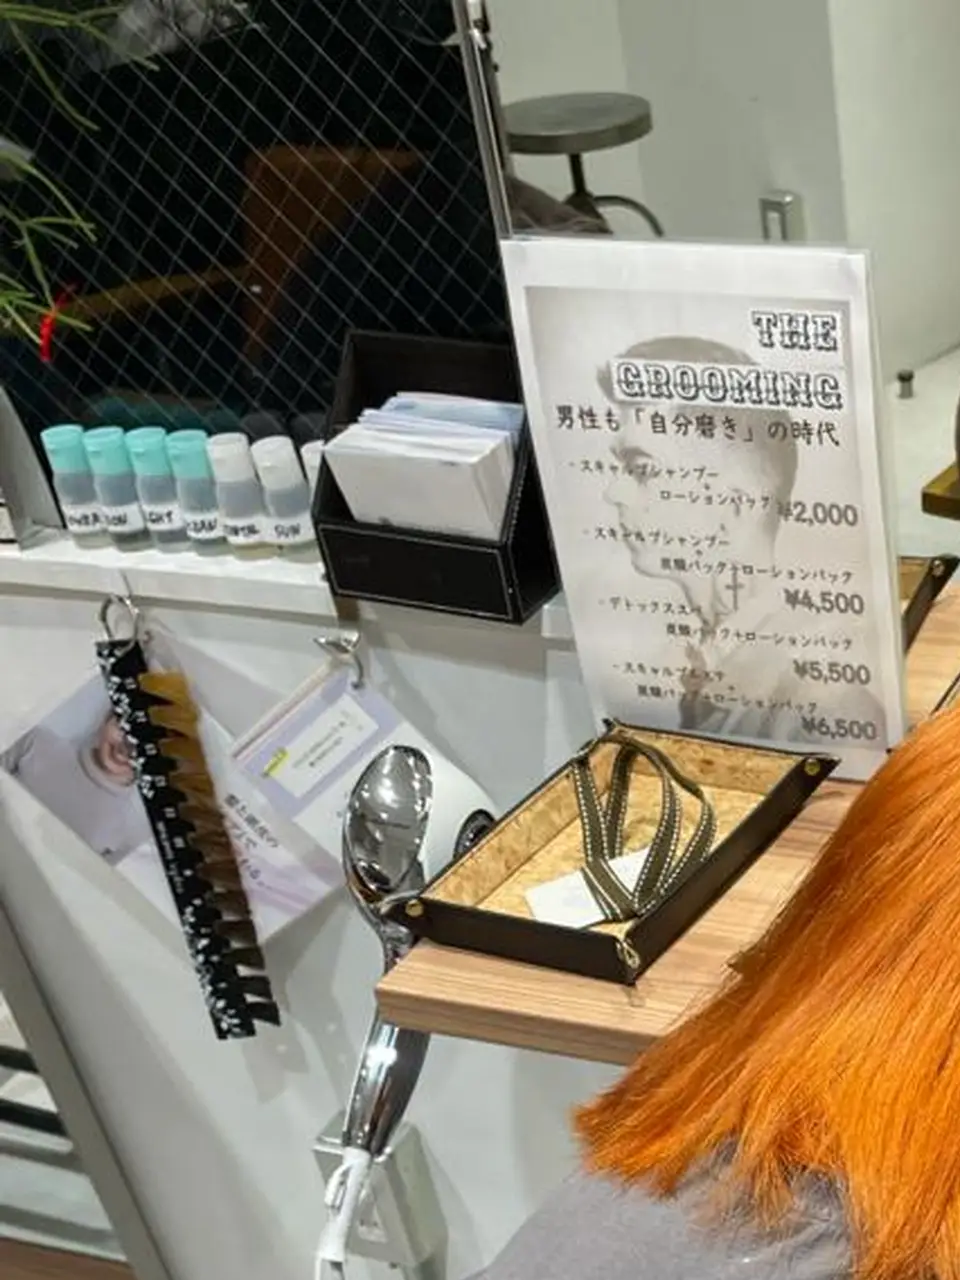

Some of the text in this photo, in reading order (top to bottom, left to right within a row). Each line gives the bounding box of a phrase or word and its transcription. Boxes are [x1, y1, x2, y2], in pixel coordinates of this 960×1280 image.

[752, 310, 839, 351] THE
[616, 361, 844, 411] GROOMING
[555, 404, 840, 447] 男性も「自分磨き」の時代
[777, 501, 859, 528] ¥2,000
[783, 587, 865, 615] ¥4,500
[793, 658, 871, 686] ¥5,500
[801, 716, 878, 741] ¥6,500
